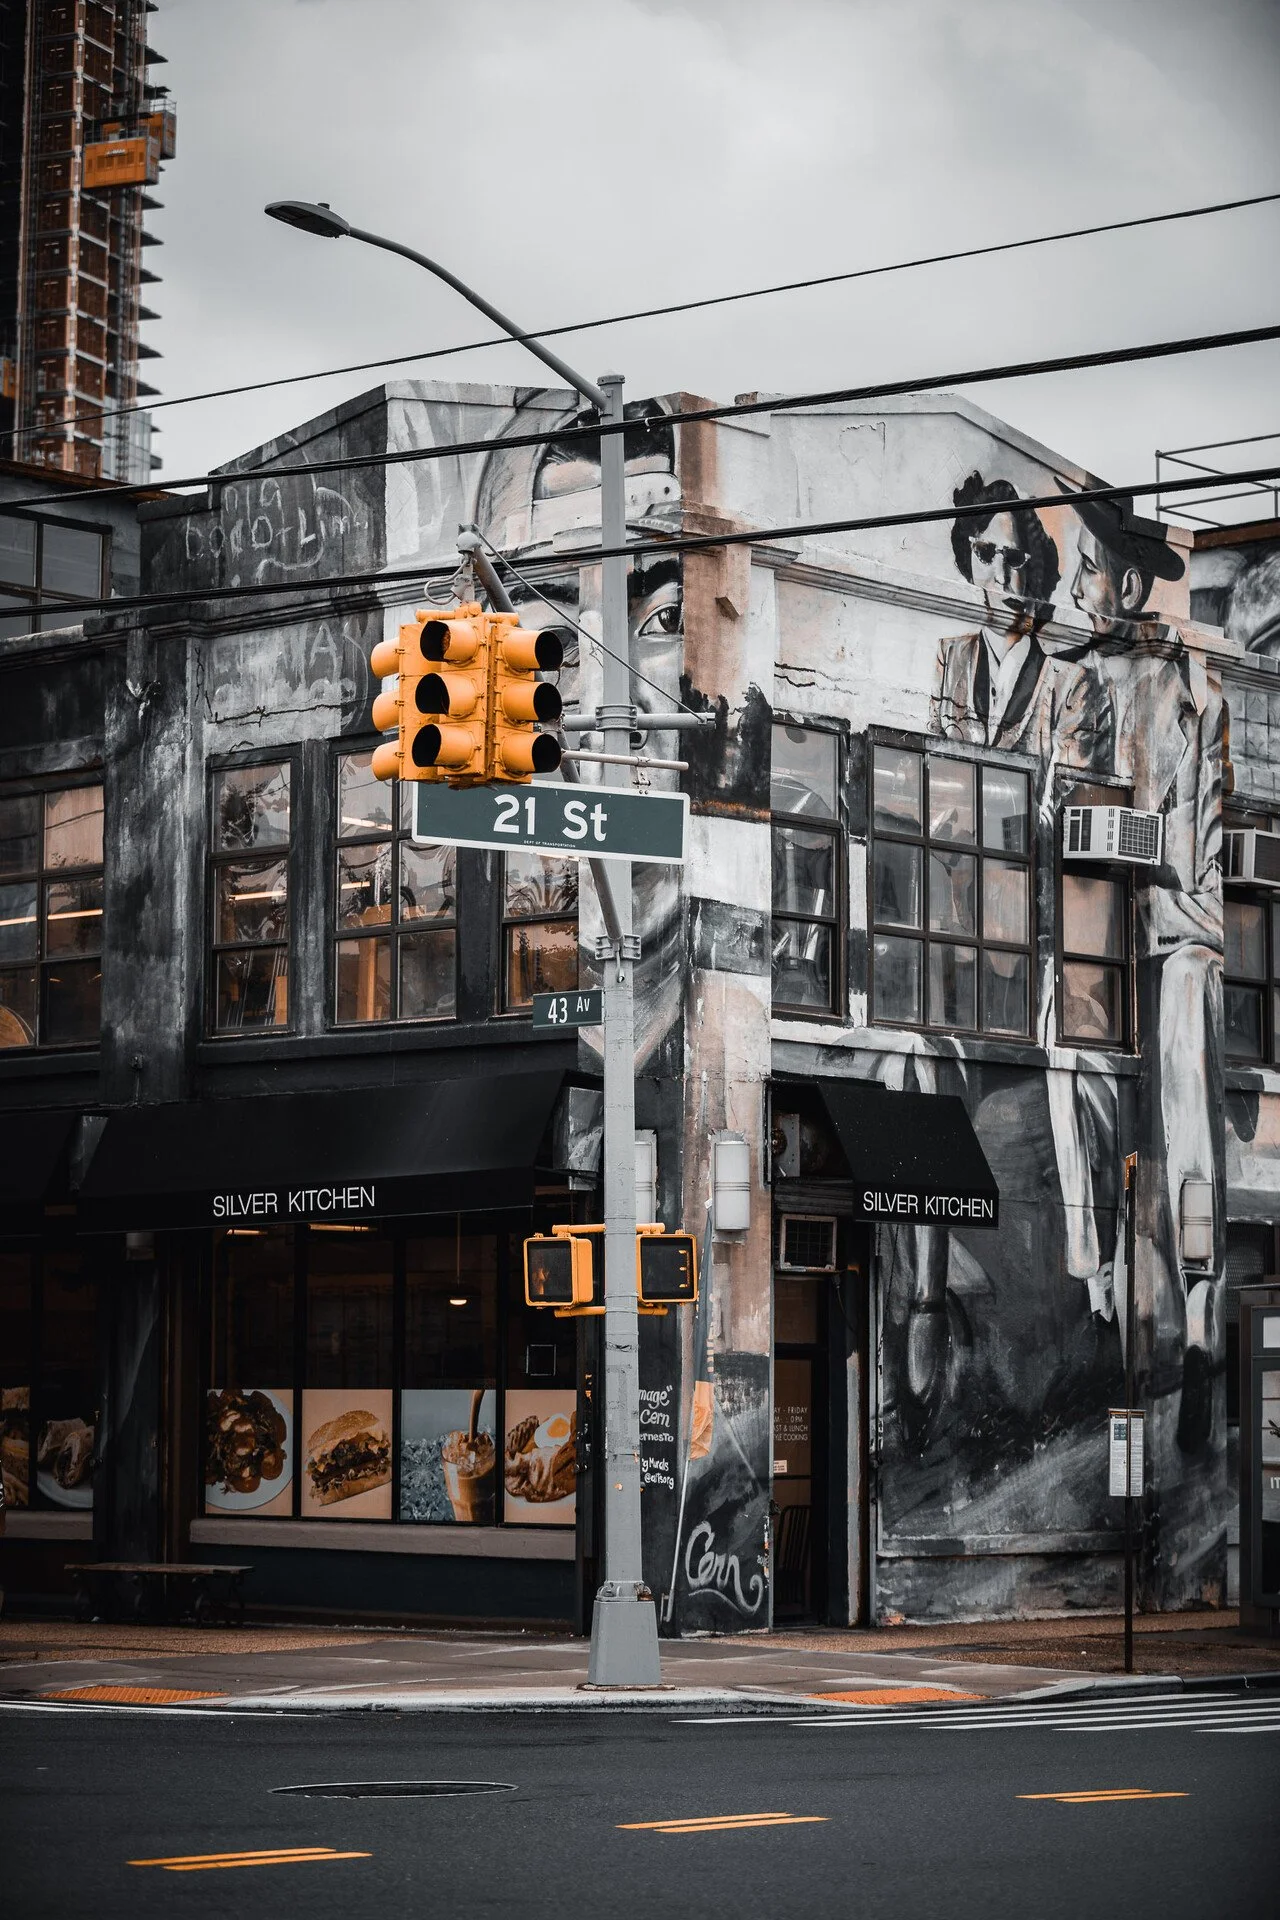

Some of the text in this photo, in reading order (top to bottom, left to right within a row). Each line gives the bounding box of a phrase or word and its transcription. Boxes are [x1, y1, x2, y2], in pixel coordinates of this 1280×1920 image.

[493, 793, 608, 842] 21 St
[548, 997, 568, 1024] 43
[213, 1185, 375, 1217] SILVER KITCHEN
[863, 1191, 993, 1218] SILVER KITCHEN
[640, 1409, 671, 1428] Cern
[787, 1406, 808, 1414] FRIDAY
[783, 1433, 808, 1441] COOKING
[789, 1424, 808, 1432] LUNCH
